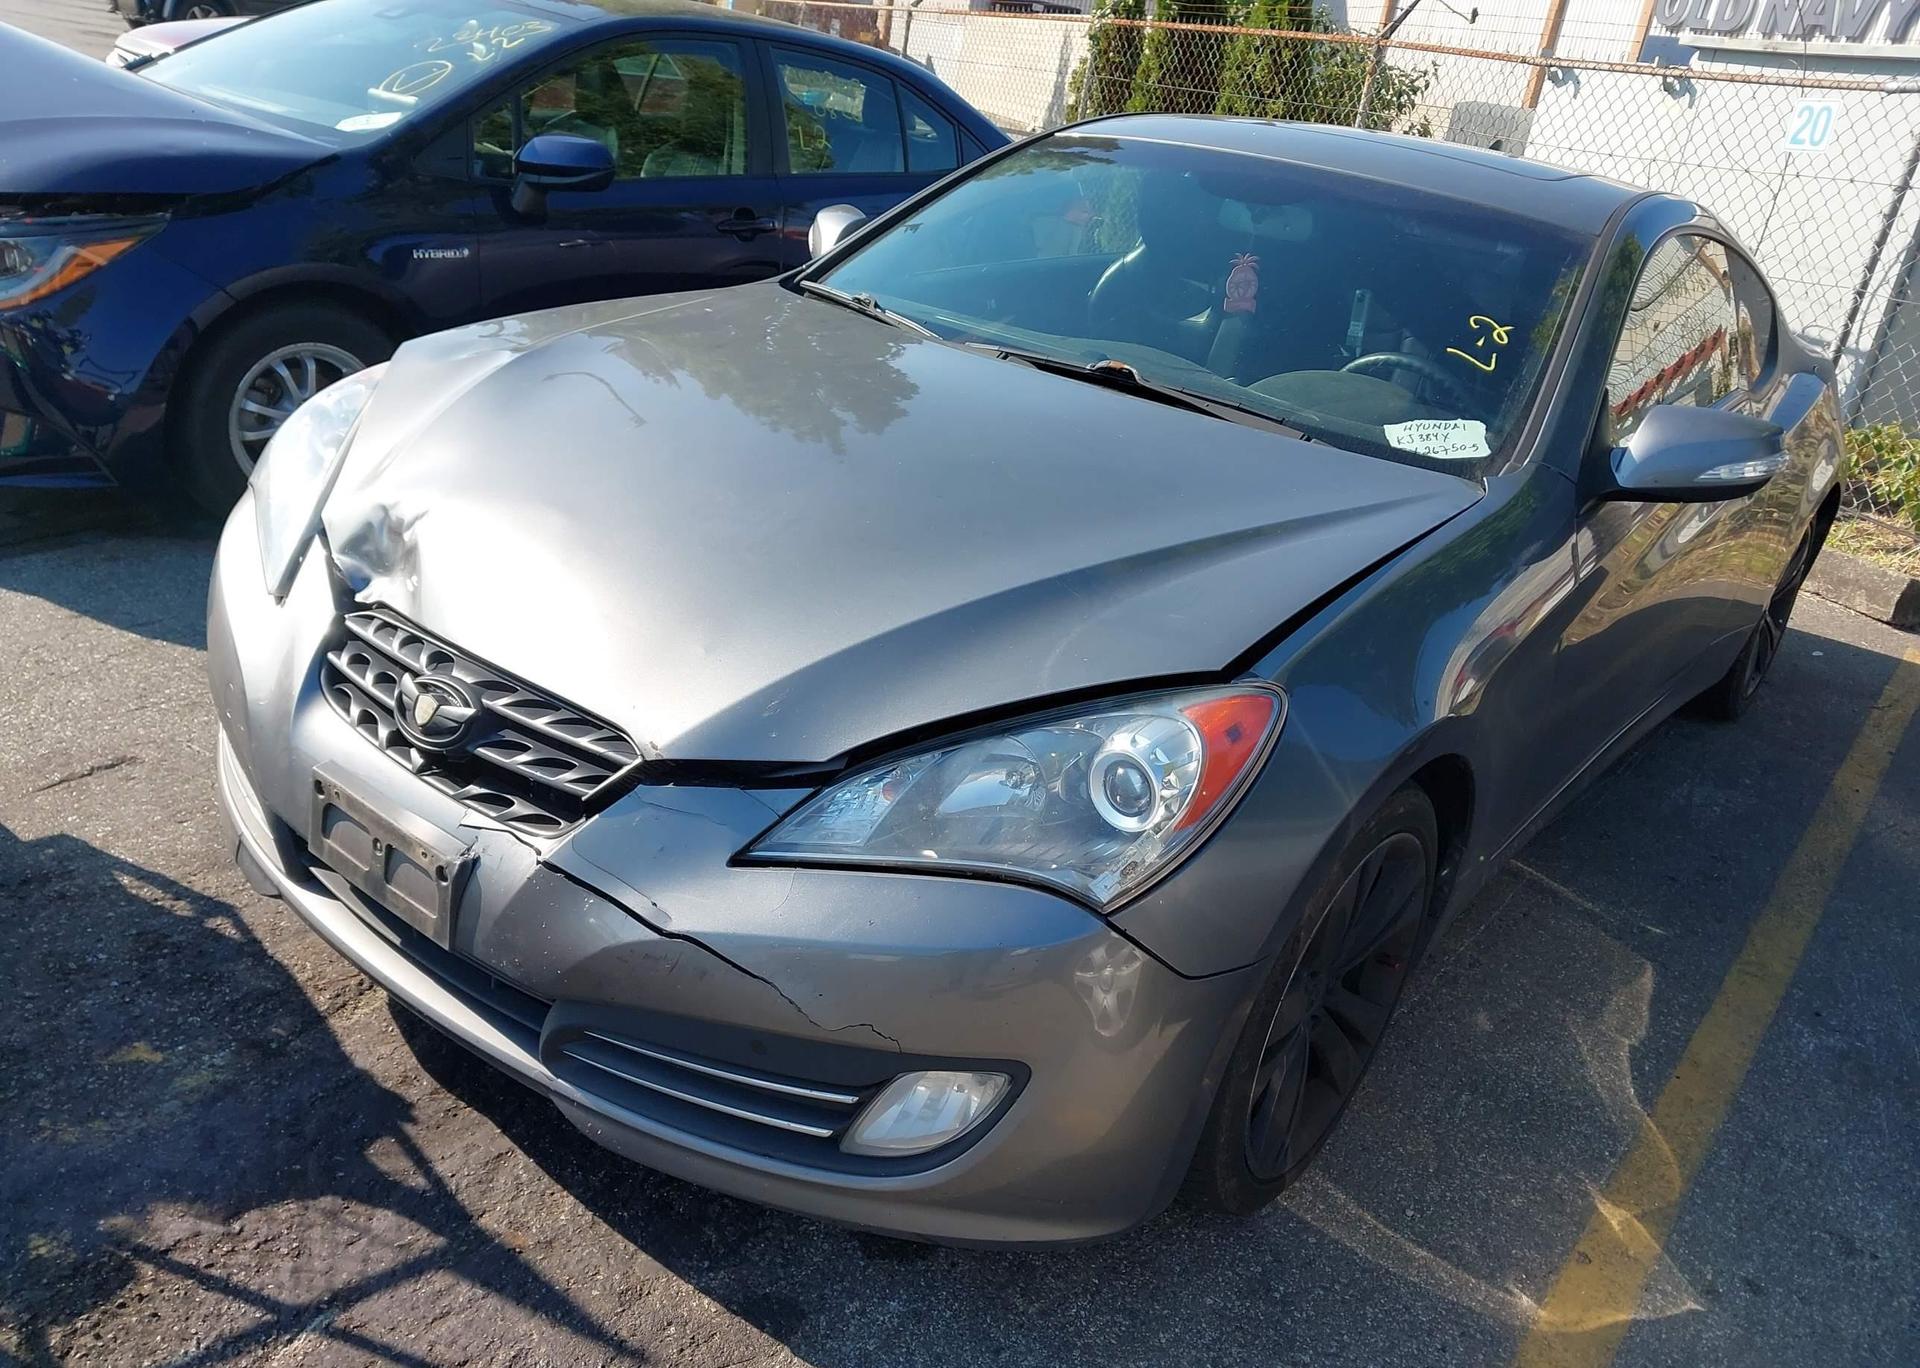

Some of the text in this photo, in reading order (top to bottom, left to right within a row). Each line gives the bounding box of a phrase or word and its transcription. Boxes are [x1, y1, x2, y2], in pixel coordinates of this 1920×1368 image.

[1656, 0, 1920, 38] OLD NAVY
[1789, 104, 1833, 147] 20
[412, 248, 461, 259] HYBRID
[1403, 422, 1466, 433] HYUNDAI
